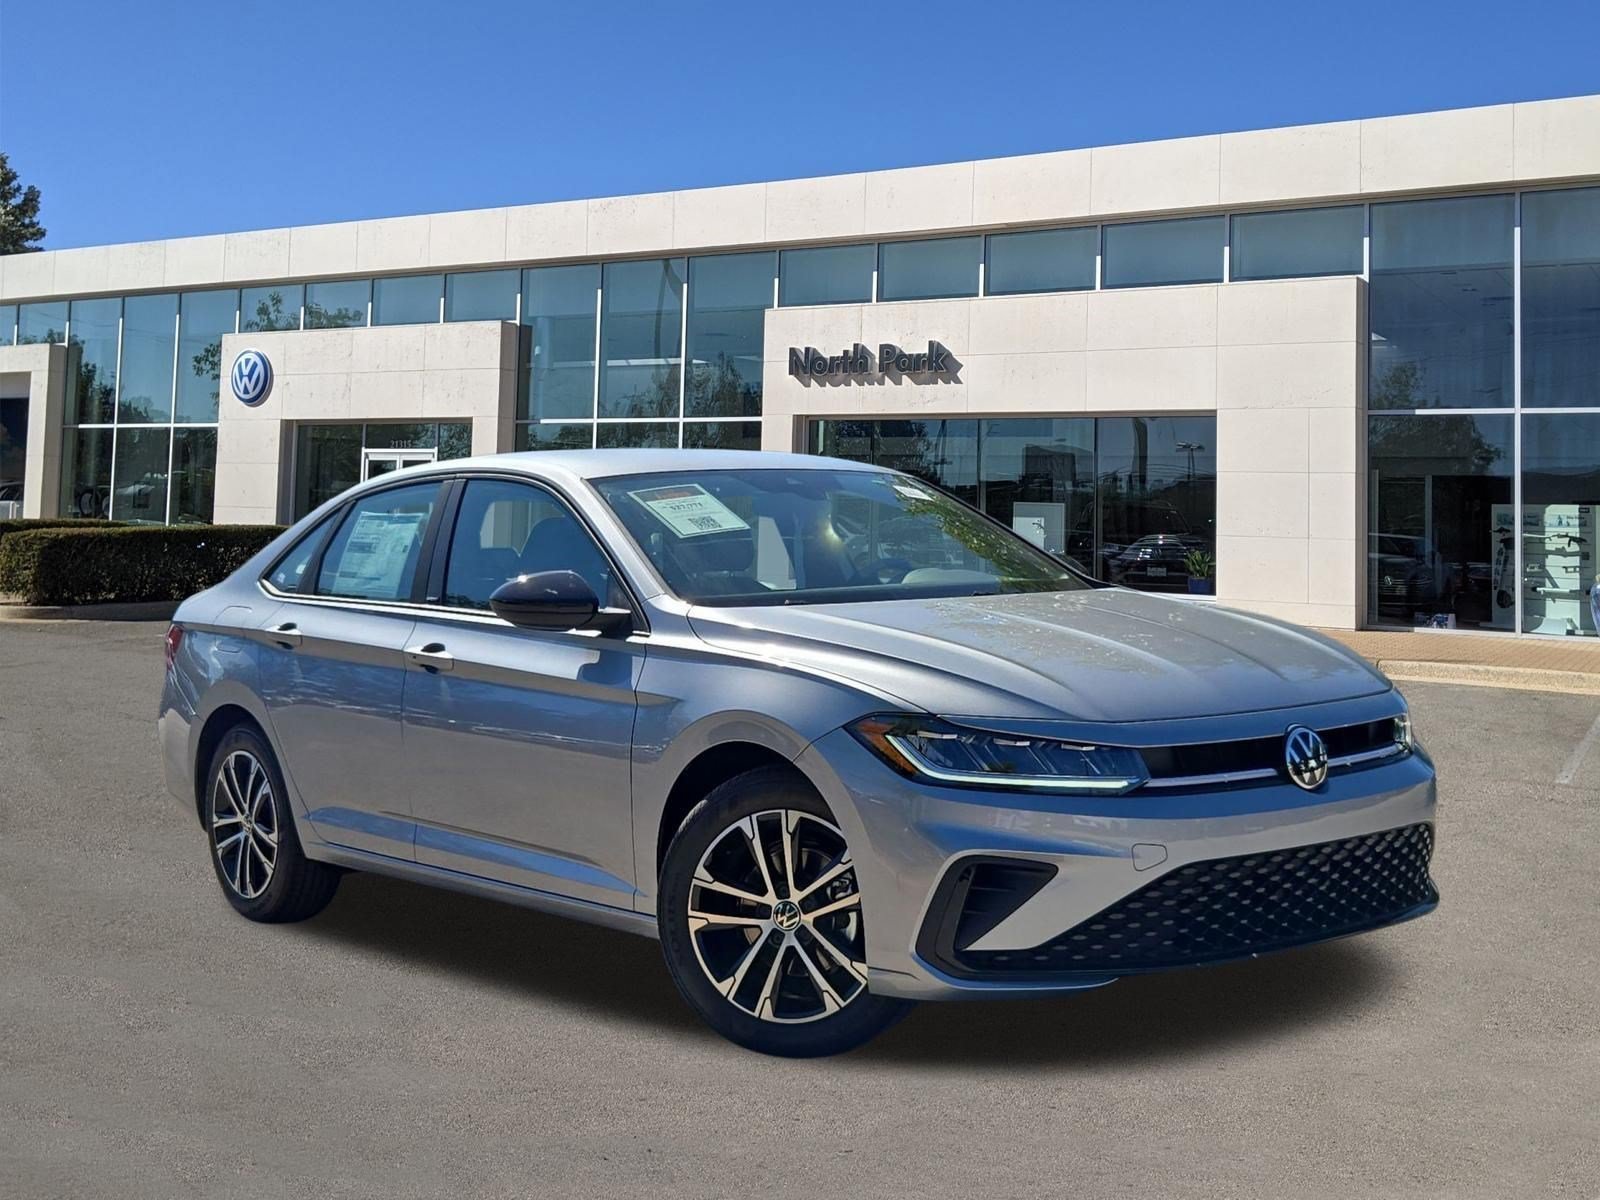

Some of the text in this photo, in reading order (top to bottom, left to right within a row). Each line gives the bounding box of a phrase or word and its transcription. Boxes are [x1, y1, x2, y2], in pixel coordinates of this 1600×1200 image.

[232, 351, 268, 402] VW
[788, 340, 952, 377] North Park
